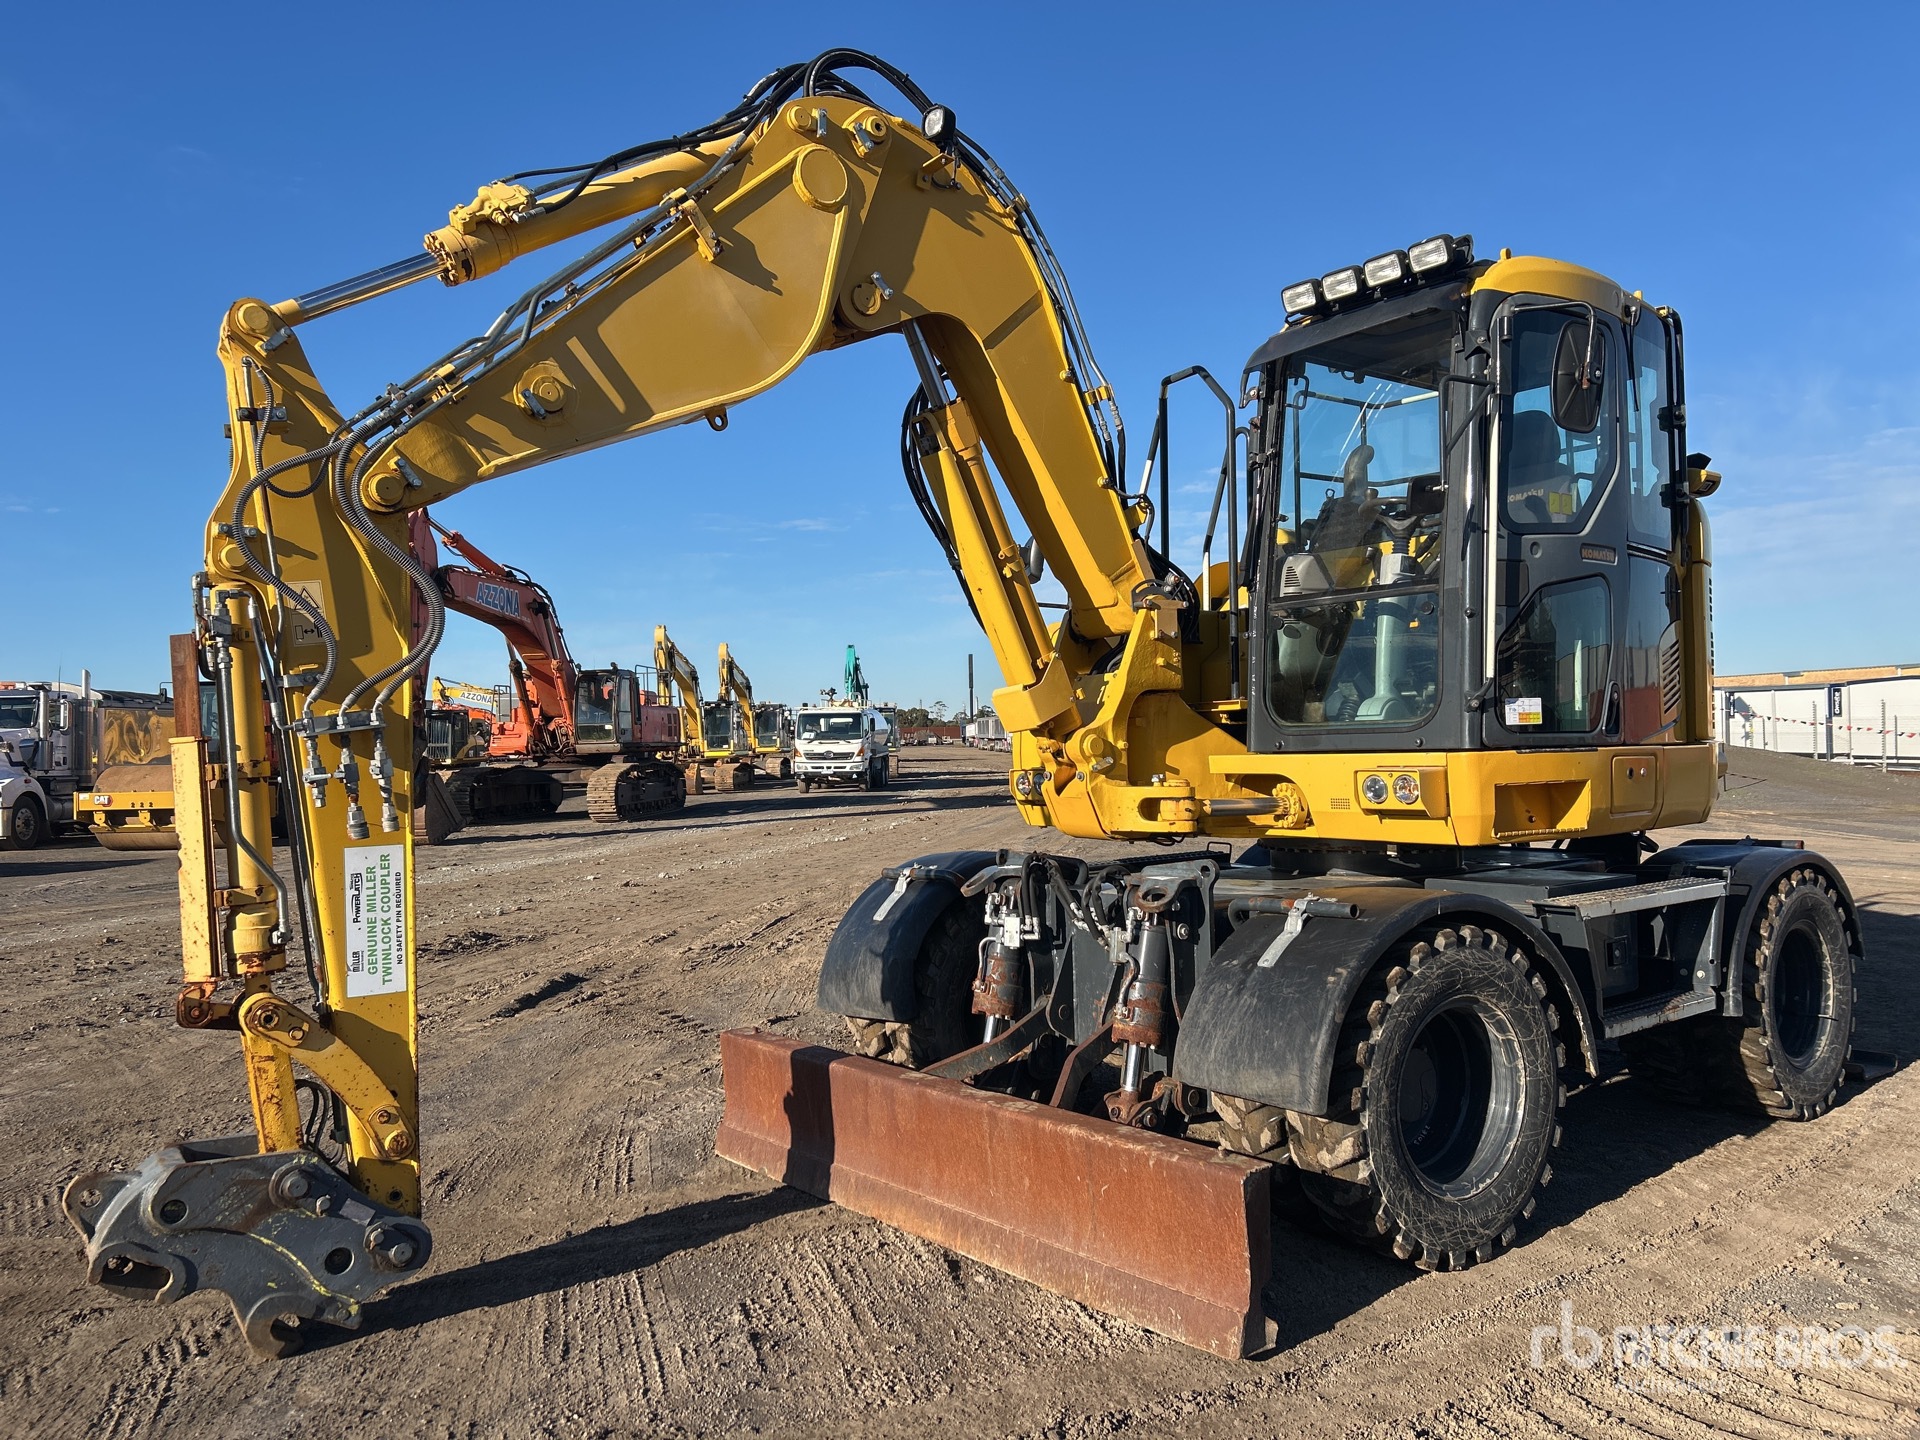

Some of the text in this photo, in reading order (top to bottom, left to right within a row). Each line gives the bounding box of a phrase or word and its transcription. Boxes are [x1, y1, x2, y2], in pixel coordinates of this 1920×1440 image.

[1581, 548, 1615, 561] KOMATSU
[475, 581, 521, 619] AZZONA
[460, 692, 493, 704] AZZONA
[94, 795, 109, 804] CAT
[394, 871, 402, 909] REQUIRED
[366, 866, 378, 975] GENUINE MILLER
[380, 853, 392, 985] TWINLOCK COUPLER
[396, 953, 403, 965] NO
